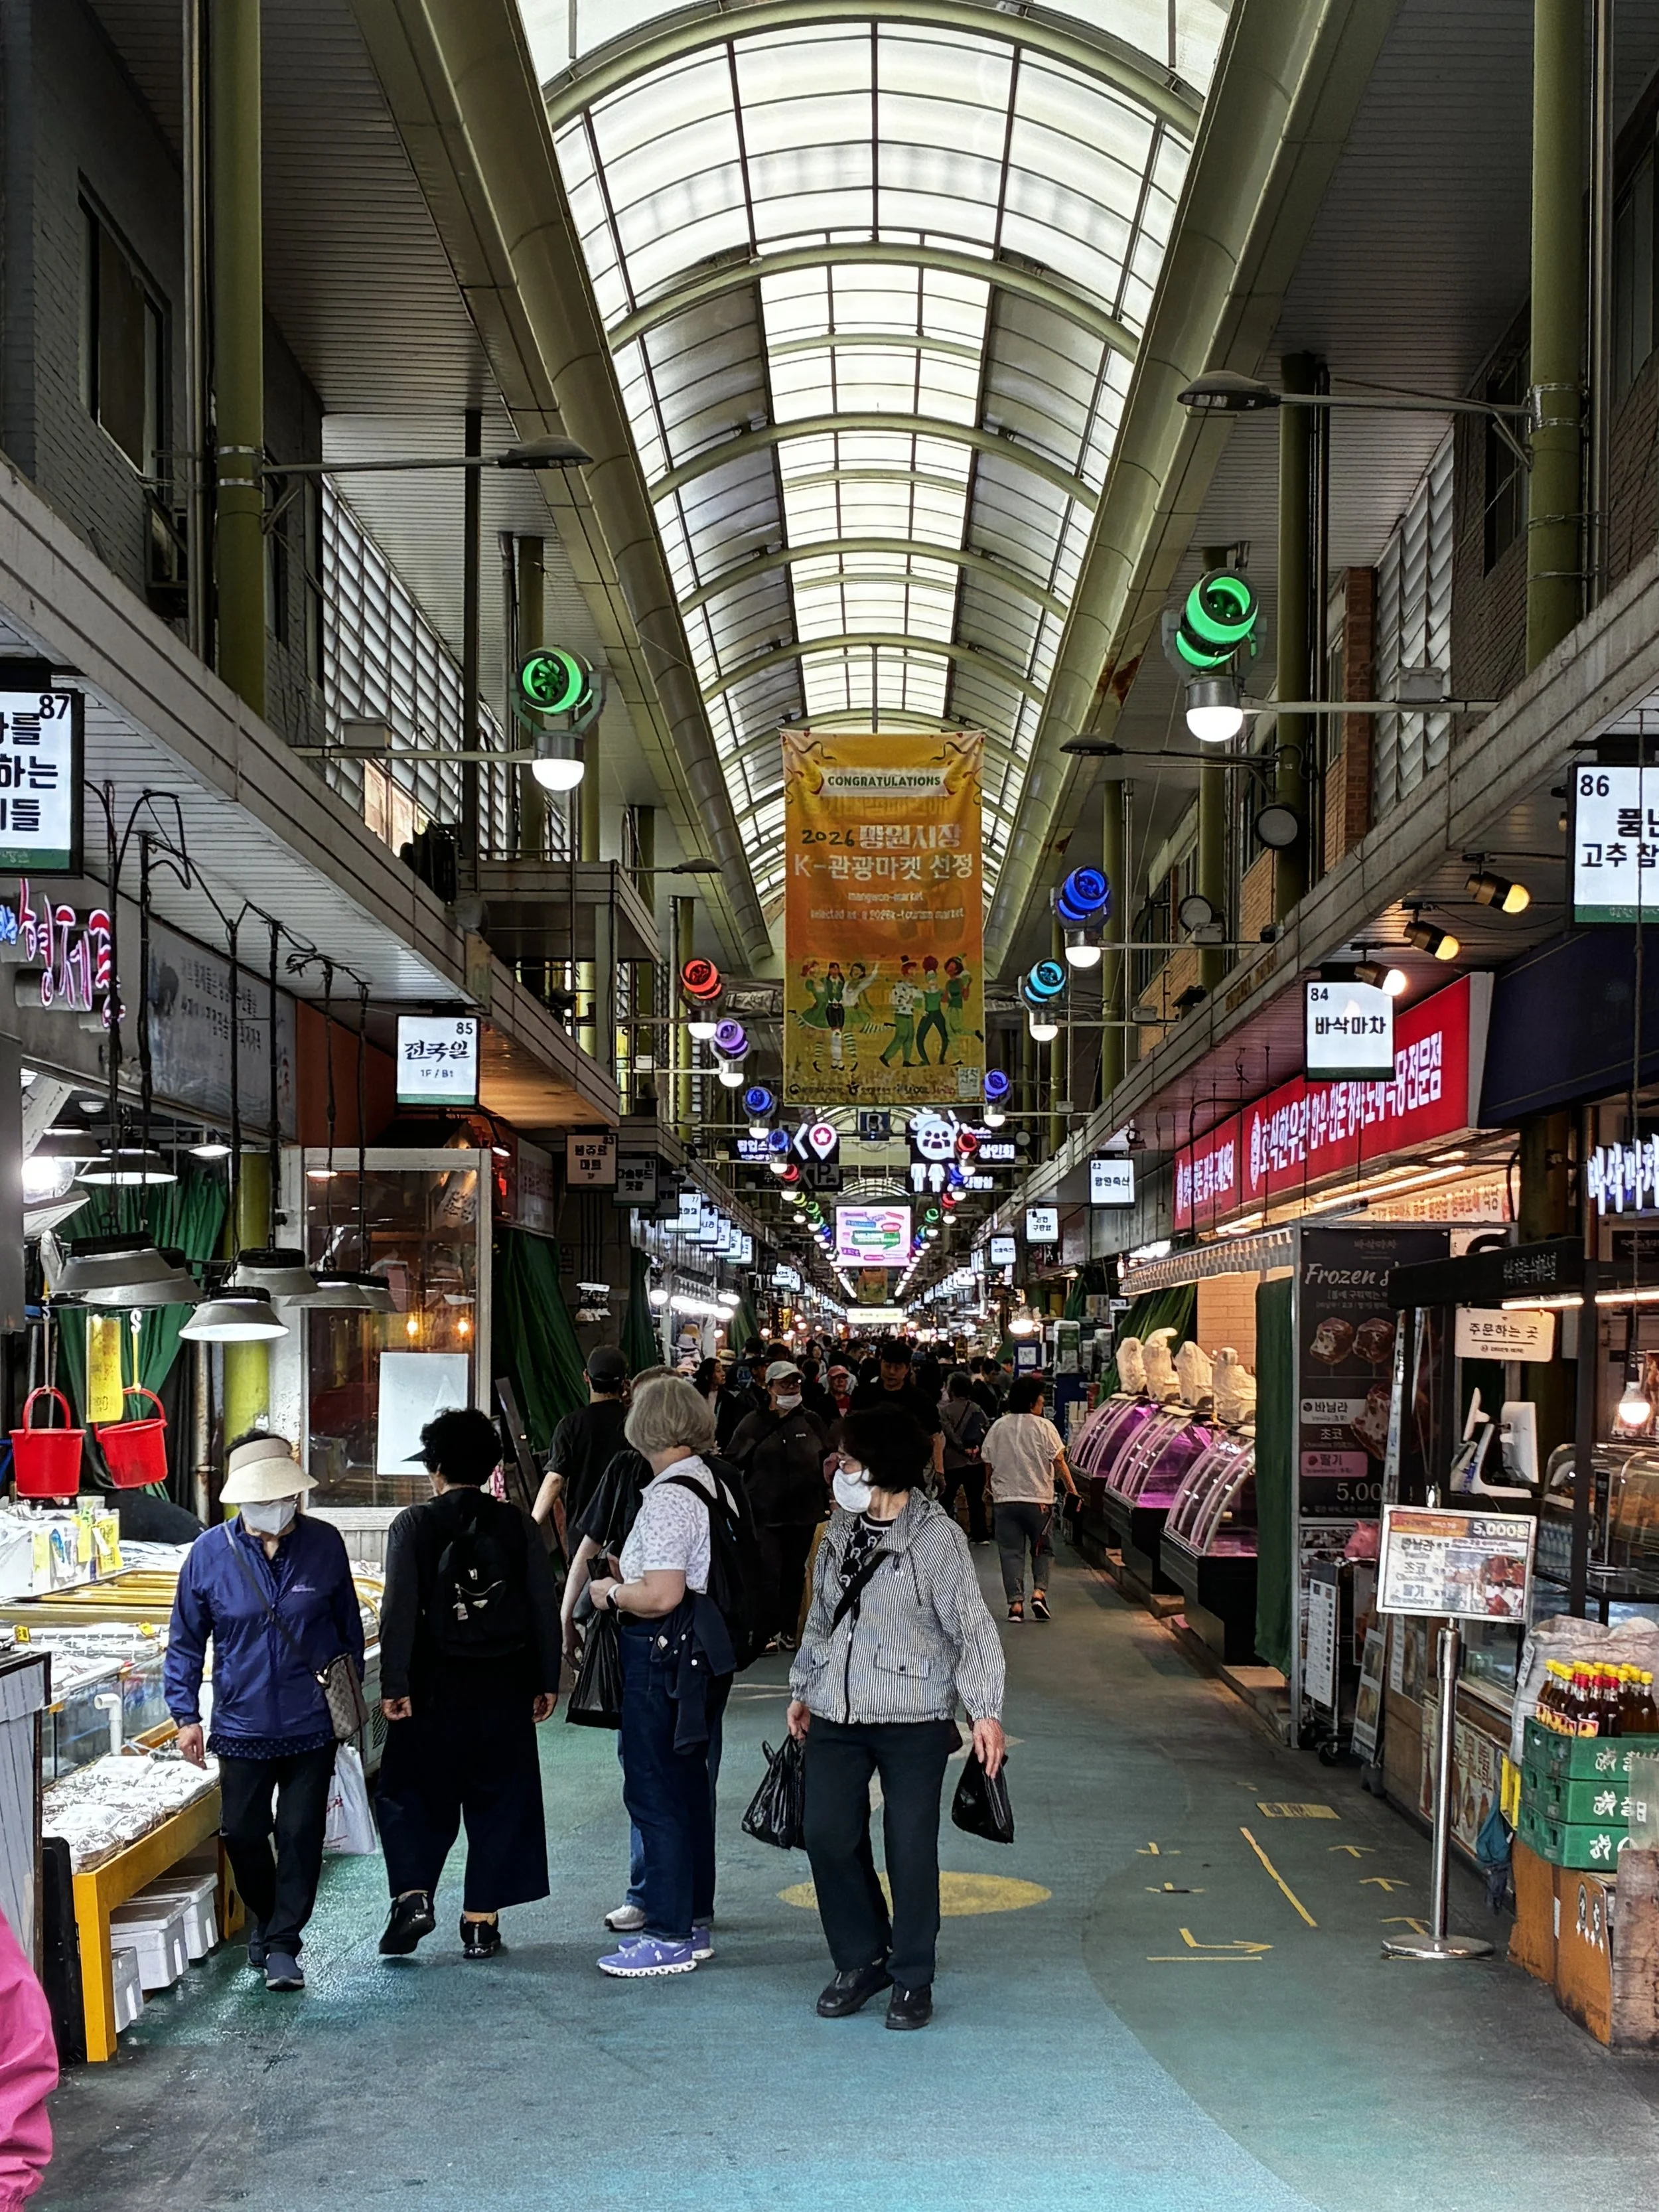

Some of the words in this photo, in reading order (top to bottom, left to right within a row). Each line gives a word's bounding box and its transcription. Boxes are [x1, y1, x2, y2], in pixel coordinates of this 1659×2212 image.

[39, 694, 70, 719] 87
[0, 711, 41, 745] 를
[827, 775, 941, 787] CONGRATULATIONS
[1580, 774, 1610, 797] 86
[0, 798, 40, 832] 들
[801, 829, 855, 847] 2026
[859, 824, 961, 849] 망원시장
[1580, 842, 1627, 868] 고추
[929, 853, 973, 879] 선정
[1311, 987, 1329, 1001] 84
[456, 1021, 473, 1035] 85
[1315, 1015, 1387, 1035] 바삭마차
[1304, 1263, 1377, 1286] Frozen
[1469, 1323, 1522, 1337] 주문하는
[1526, 1325, 1539, 1339] 곳
[1315, 1401, 1348, 1413] 바닐라
[1320, 1428, 1343, 1440] 초코
[1320, 1453, 1342, 1466] 딸기
